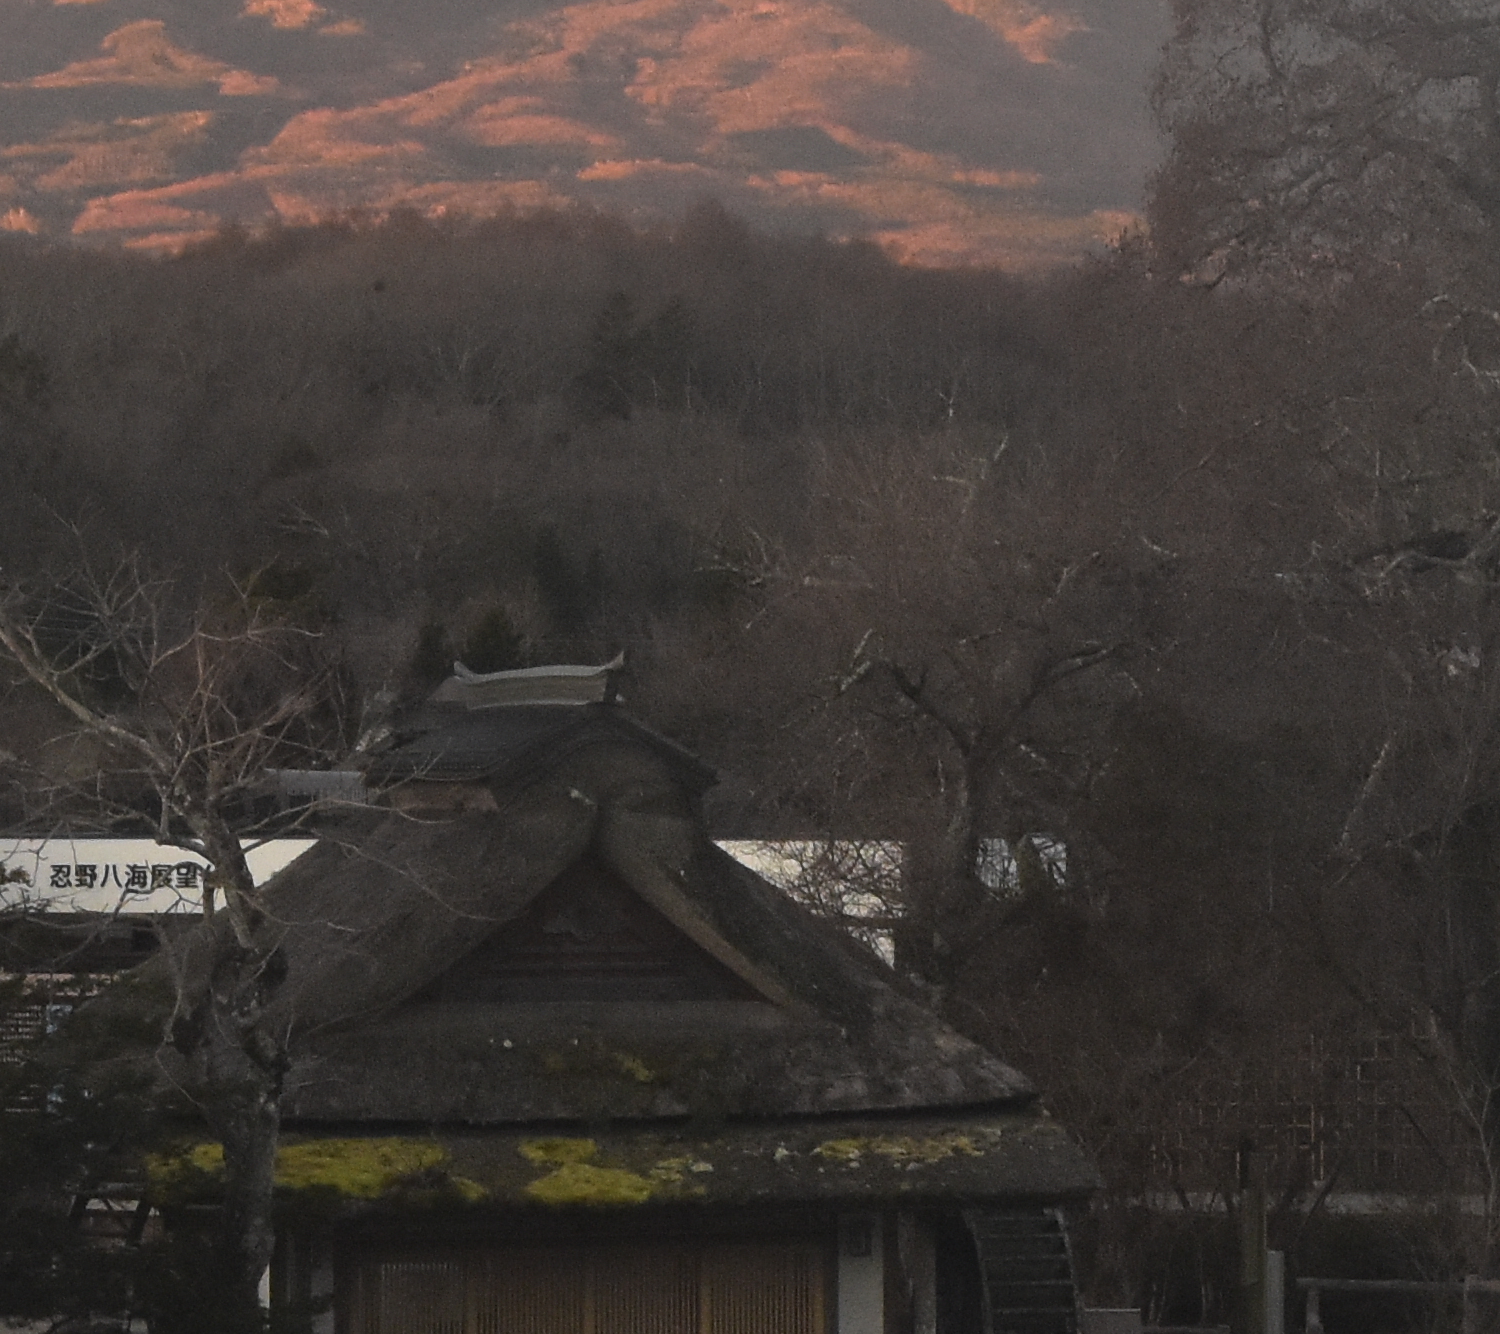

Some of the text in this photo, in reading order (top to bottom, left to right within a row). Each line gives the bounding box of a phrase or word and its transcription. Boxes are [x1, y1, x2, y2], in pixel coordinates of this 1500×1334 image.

[50, 863, 213, 888] 忍野八海展望
